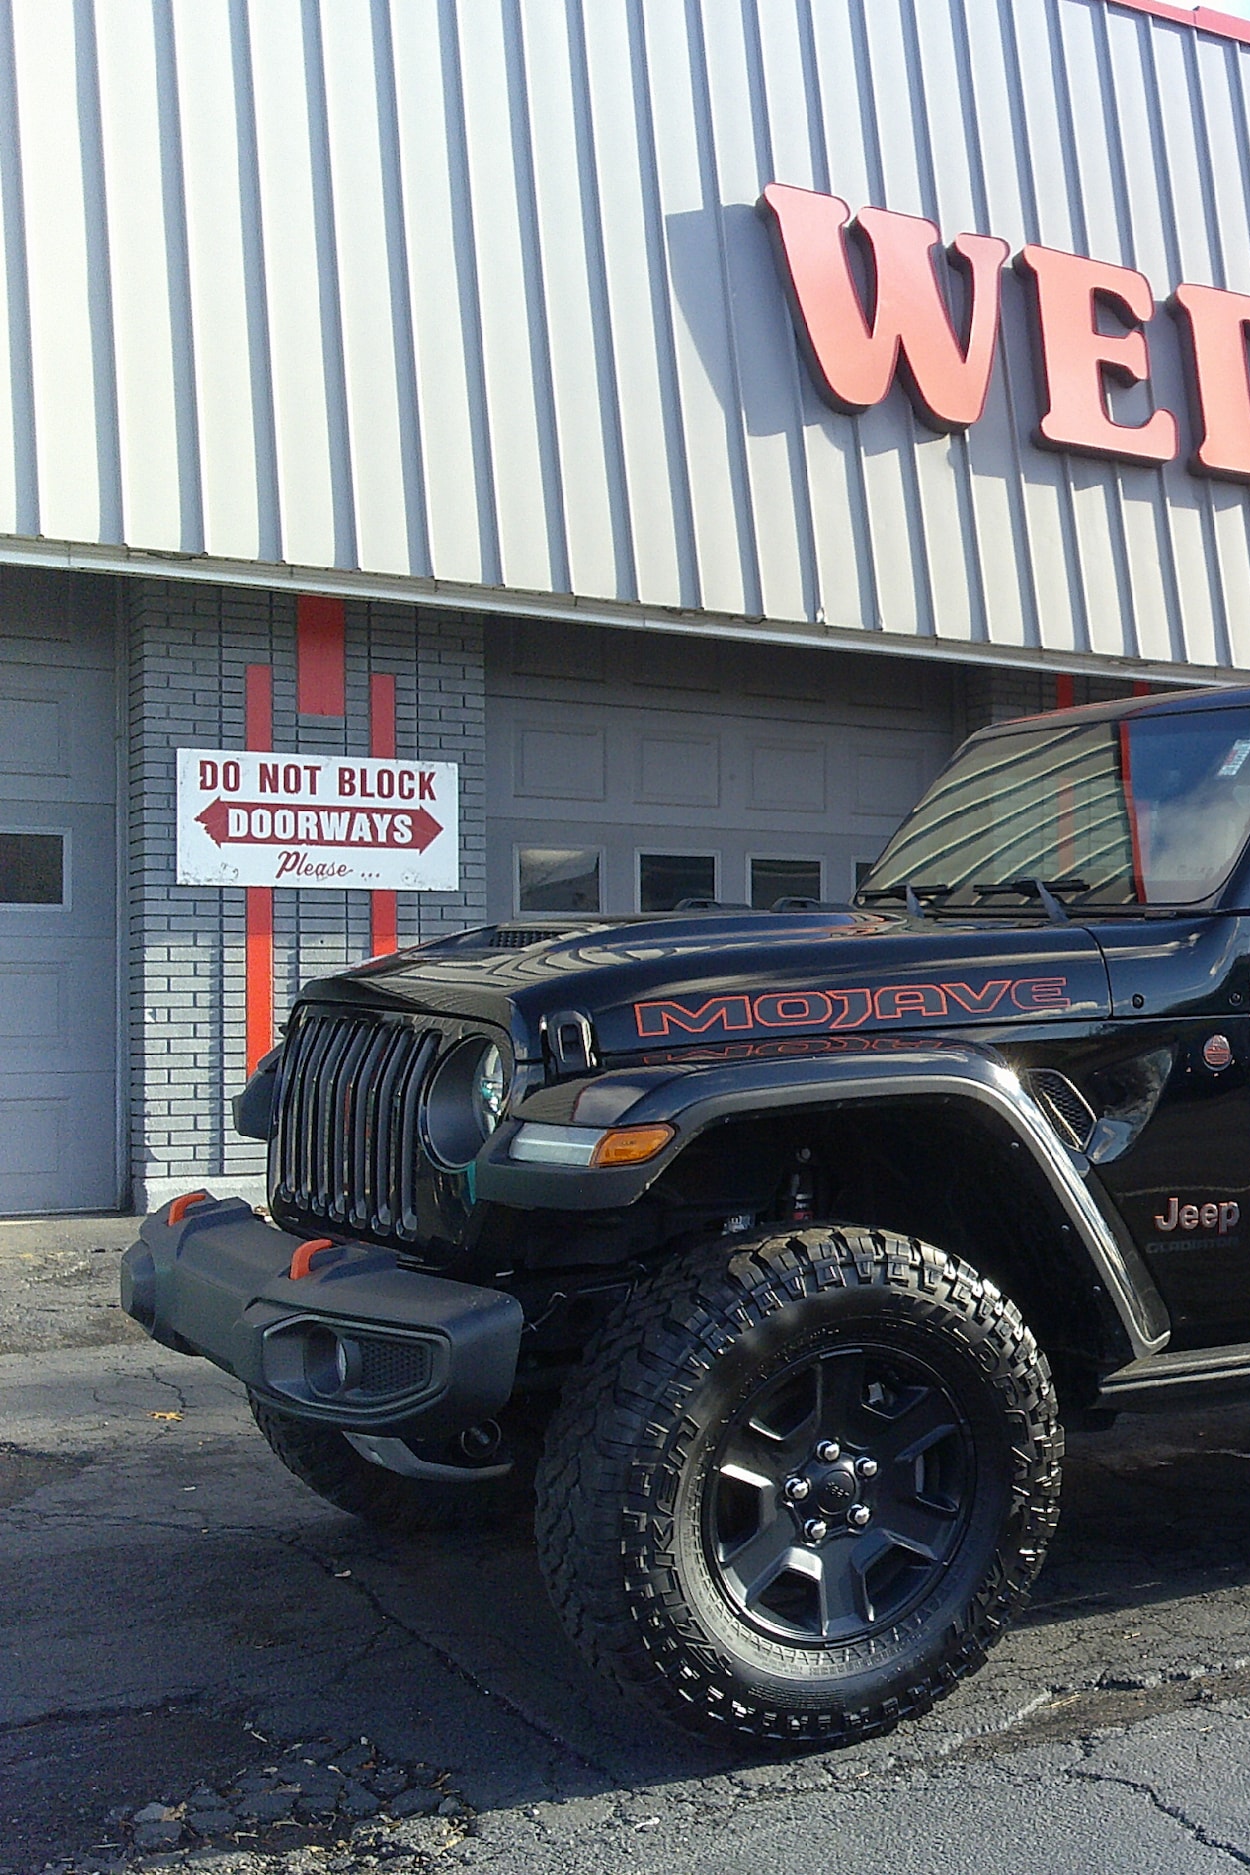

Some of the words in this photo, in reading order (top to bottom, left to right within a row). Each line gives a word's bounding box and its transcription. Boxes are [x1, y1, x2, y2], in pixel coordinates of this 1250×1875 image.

[199, 760, 241, 792] DO
[259, 763, 321, 795] NOT
[338, 766, 437, 801] BLOCK
[227, 808, 413, 843] DOORWAYS
[275, 850, 353, 879] Please
[633, 977, 1071, 1038] MOJAVE
[1153, 1195, 1241, 1235] Jeep
